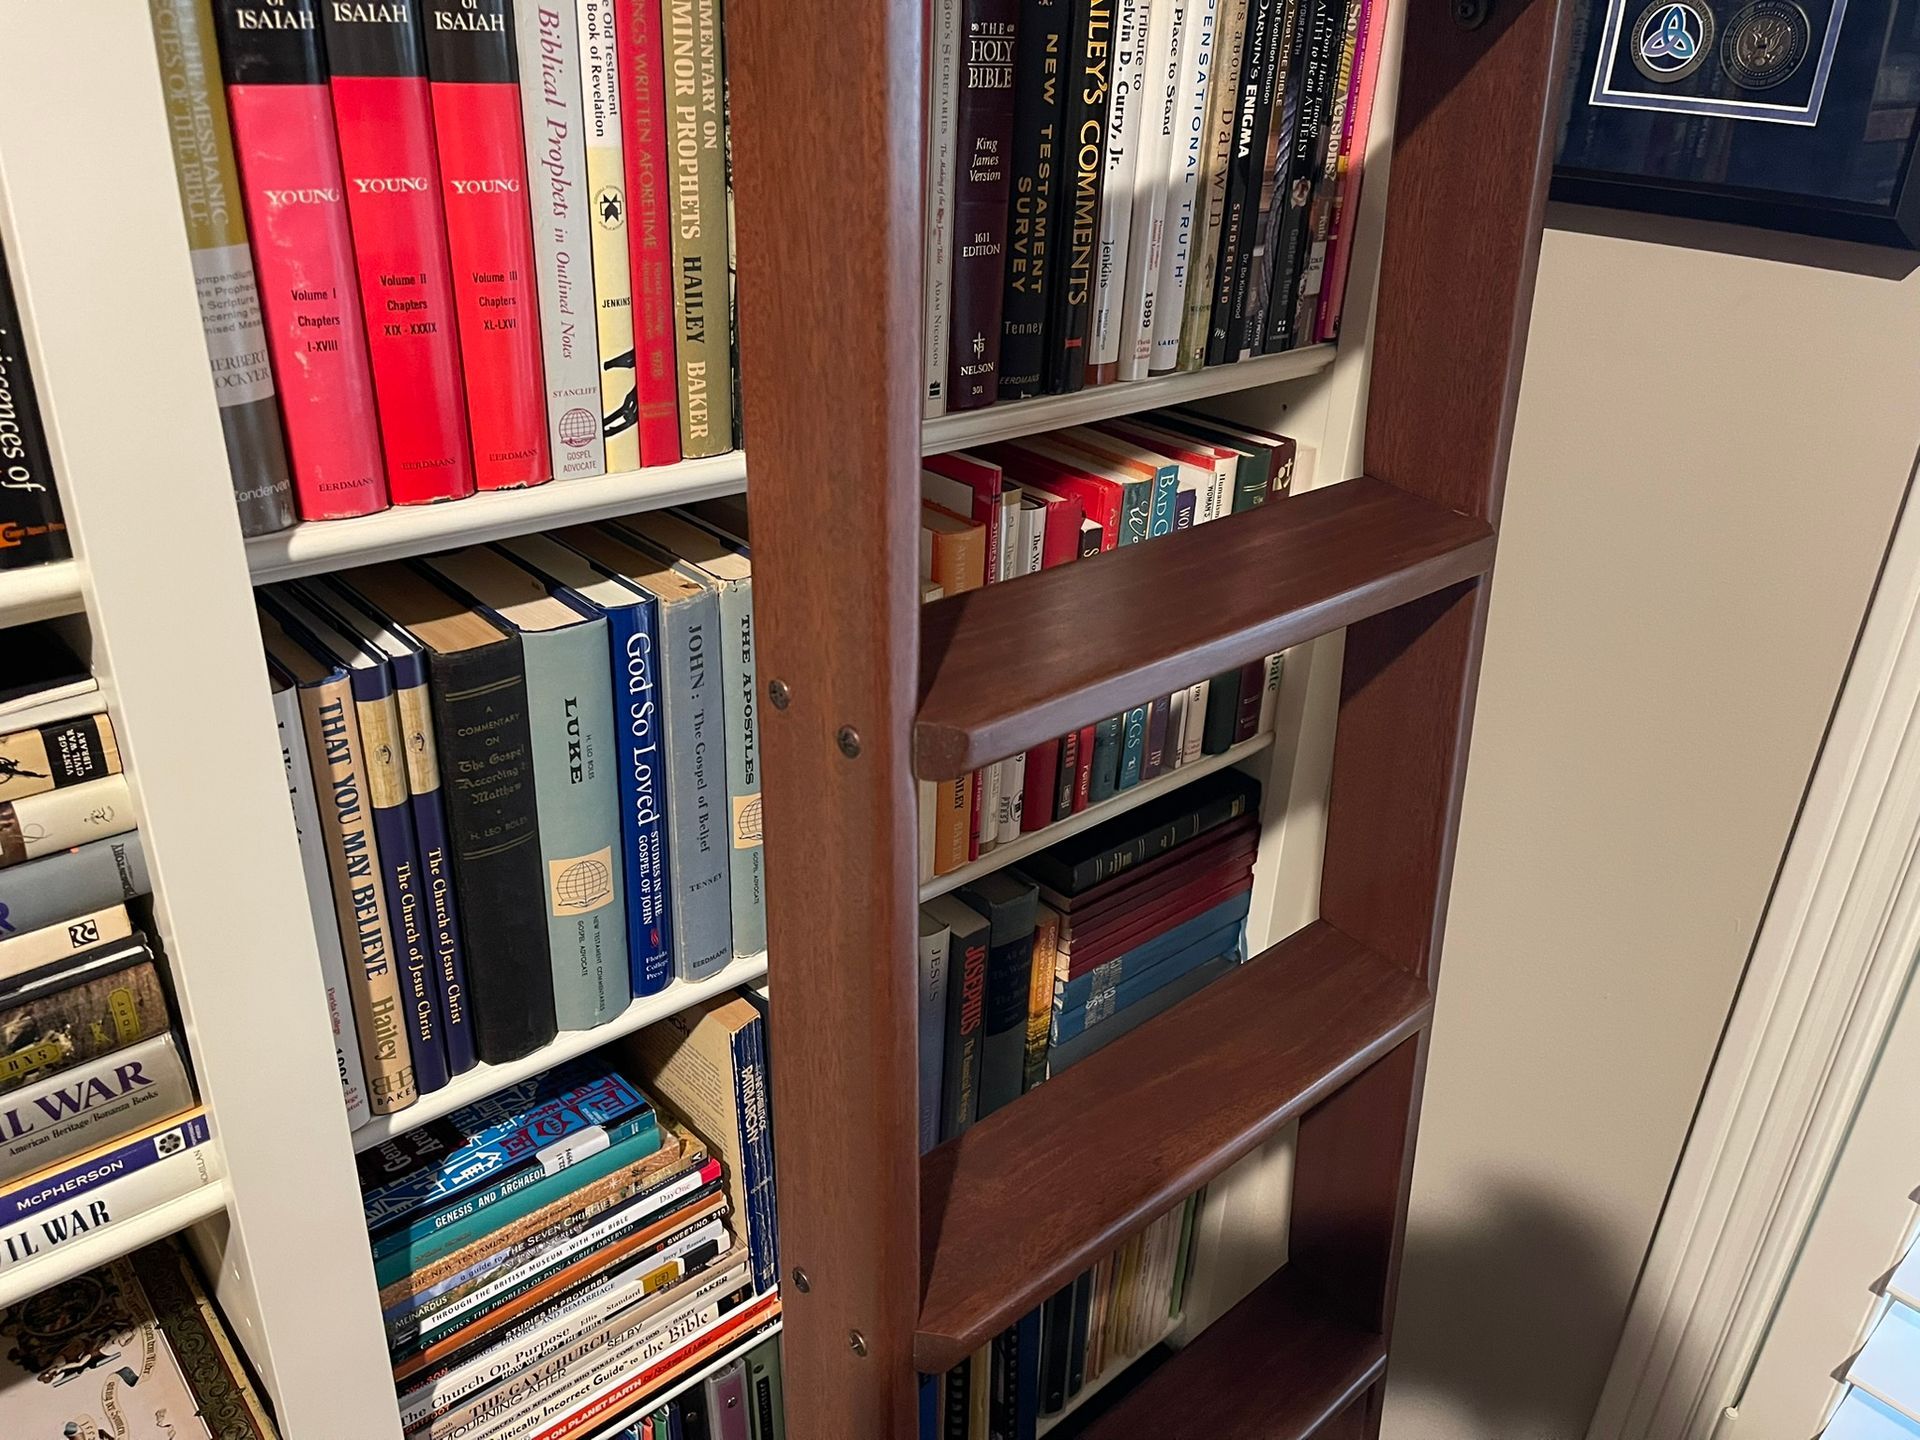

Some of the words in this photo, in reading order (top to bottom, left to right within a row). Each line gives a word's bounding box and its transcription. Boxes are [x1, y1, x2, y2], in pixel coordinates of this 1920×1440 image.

[237, 10, 315, 29] ISAIAH
[332, 3, 408, 23] ISAIAH
[434, 12, 504, 31] ISAIAH
[586, 3, 600, 40] Book
[603, 13, 614, 40] Old
[981, 22, 1005, 34] THE
[671, 0, 697, 96] MINOR
[1131, 5, 1150, 67] Tribute
[1170, 8, 1185, 57] Place
[1250, 0, 1268, 81] DARWIN'S
[1270, 16, 1283, 65] Evolution
[538, 4, 565, 108] Biblical
[591, 45, 600, 61] of
[970, 41, 1015, 62] HOLY
[1043, 34, 1058, 104] NEW
[604, 43, 617, 116] Testament
[968, 67, 1012, 89] BIBLE
[1133, 73, 1143, 91] to
[1166, 63, 1176, 84] to
[1263, 64, 1275, 105] Delusion
[592, 64, 604, 138] Revelation
[632, 54, 651, 141] WRITTEN
[1110, 81, 1129, 140] Curry,
[1162, 85, 1177, 136] Stand
[704, 121, 718, 149] ON
[1238, 84, 1257, 159] ENIGMA
[1296, 98, 1313, 160] ATHEIST
[971, 155, 999, 168] James
[975, 138, 998, 152] King
[1109, 148, 1124, 170] Jr.
[542, 115, 571, 219] Prophets
[676, 104, 701, 239] PROPHETS
[969, 170, 1001, 183] Version
[1208, 108, 1233, 228] Darwin
[264, 189, 340, 207] YOUNG
[352, 178, 428, 193] YOUNG
[450, 180, 519, 193] YOUNG
[640, 150, 659, 248] AFORETIME
[1031, 124, 1053, 295] TESTAMENT
[1068, 119, 1101, 305] COMMENTS
[554, 226, 566, 244] in
[963, 244, 1000, 258] EDITION
[975, 233, 990, 244] 1611
[1012, 177, 1032, 293] SURVEY
[1100, 240, 1115, 289] Jenkins
[1220, 203, 1240, 305] SUNDERLAND
[292, 291, 328, 302] Volume
[380, 275, 416, 286] Volume
[420, 274, 427, 284] II
[473, 274, 505, 284] Volume
[556, 251, 574, 315] Outlined
[388, 301, 427, 311] Chapters
[479, 298, 516, 307] Chapters
[602, 297, 631, 309] JENKINS
[683, 256, 706, 344] HAILEY
[1142, 291, 1153, 328] 1999
[298, 317, 340, 328] Chapters
[384, 323, 403, 336] XIX
[410, 323, 437, 335] XXXIX
[483, 321, 516, 331] XL-LXVI
[561, 321, 576, 360] Notes
[1005, 321, 1043, 335] Tenney
[308, 341, 338, 352] I-XVIII
[960, 362, 994, 376] NELSON
[553, 387, 597, 398] STANCLIFF
[687, 360, 709, 440] BAKER
[971, 386, 984, 395] 301
[402, 459, 455, 470] EERDMANS
[489, 450, 537, 461] EERDMANS
[563, 460, 597, 475] ADVOCATE
[567, 451, 591, 462] GOSPEL
[8, 466, 46, 492] of
[319, 478, 374, 492] EERDMANS
[741, 614, 752, 663] THE
[627, 632, 653, 696] God
[319, 697, 353, 765] THAT
[457, 713, 521, 737] COMMENTARY
[631, 701, 654, 737] So
[693, 709, 705, 740] The
[743, 673, 755, 785] APOSTLES
[58, 735, 74, 776] VINTAGE
[77, 732, 93, 770] LIBRARY
[458, 760, 485, 773] The
[489, 744, 526, 765] Gospel
[485, 736, 500, 746] ON
[564, 697, 583, 785] LUKE
[73, 751, 85, 777] CIVIL
[455, 769, 519, 790] According
[693, 744, 708, 791] Gospel
[333, 772, 362, 824] YOU
[472, 782, 522, 805] Matthew
[633, 742, 660, 828] Loved
[697, 812, 710, 853] Belief
[342, 830, 373, 879] MAY
[428, 847, 443, 876] The
[639, 835, 650, 878] GOSPEL
[650, 831, 661, 876] STUDIES
[397, 862, 415, 890] The
[689, 872, 723, 893] TENNEY
[401, 890, 422, 945] Church
[432, 878, 452, 928] Church
[642, 895, 652, 925] JOHN
[655, 893, 664, 917] THE
[351, 882, 389, 981] BELIEVE
[439, 931, 452, 949] of
[408, 947, 422, 964] of
[439, 948, 456, 982] Jesus
[580, 946, 589, 977] ADVOCATE
[692, 947, 729, 968] EERDMANS
[408, 963, 425, 999] Jesus
[646, 970, 664, 981] Press
[930, 948, 942, 1002] JESUS
[960, 945, 986, 1037] JOSEPHUS
[417, 1001, 432, 1041] Christ
[446, 984, 462, 1024] Christ
[372, 996, 397, 1060] Hailey
[34, 1061, 154, 1120] WAR
[741, 1064, 760, 1144] PATRIARCHY
[9, 1132, 50, 1157] American
[133, 1092, 159, 1111] Books
[17, 1159, 124, 1211] McPHERSON
[42, 1200, 112, 1241] WAR
[434, 1203, 474, 1230] GENESIS
[478, 1191, 497, 1209] AND
[468, 1260, 493, 1281] guide
[528, 1224, 561, 1247] SEVEN
[564, 1199, 615, 1226] CHURCHES
[599, 1222, 635, 1249] OBSERVED
[432, 1299, 472, 1323] THROUGH
[475, 1288, 491, 1301] THE
[494, 1272, 527, 1292] BRITISH
[529, 1251, 563, 1274] MUSEUM
[591, 1227, 606, 1241] THE
[608, 1214, 630, 1231] BIBLE
[395, 1297, 448, 1328] MEINARDUS
[505, 1311, 546, 1340] STUDIES
[560, 1275, 609, 1307] PROVERBS
[562, 1282, 616, 1315] REMARRIAGE
[431, 1376, 485, 1412] Church
[490, 1362, 511, 1381] On
[514, 1328, 571, 1367] Purpose
[580, 1314, 597, 1328] Ellis
[527, 1369, 567, 1398] AFTER
[607, 1323, 643, 1350] SELBY
[543, 1388, 590, 1418] Incorrect
[644, 1341, 666, 1360] the
[670, 1313, 710, 1347] Bible
[567, 1399, 612, 1430] PLANET
